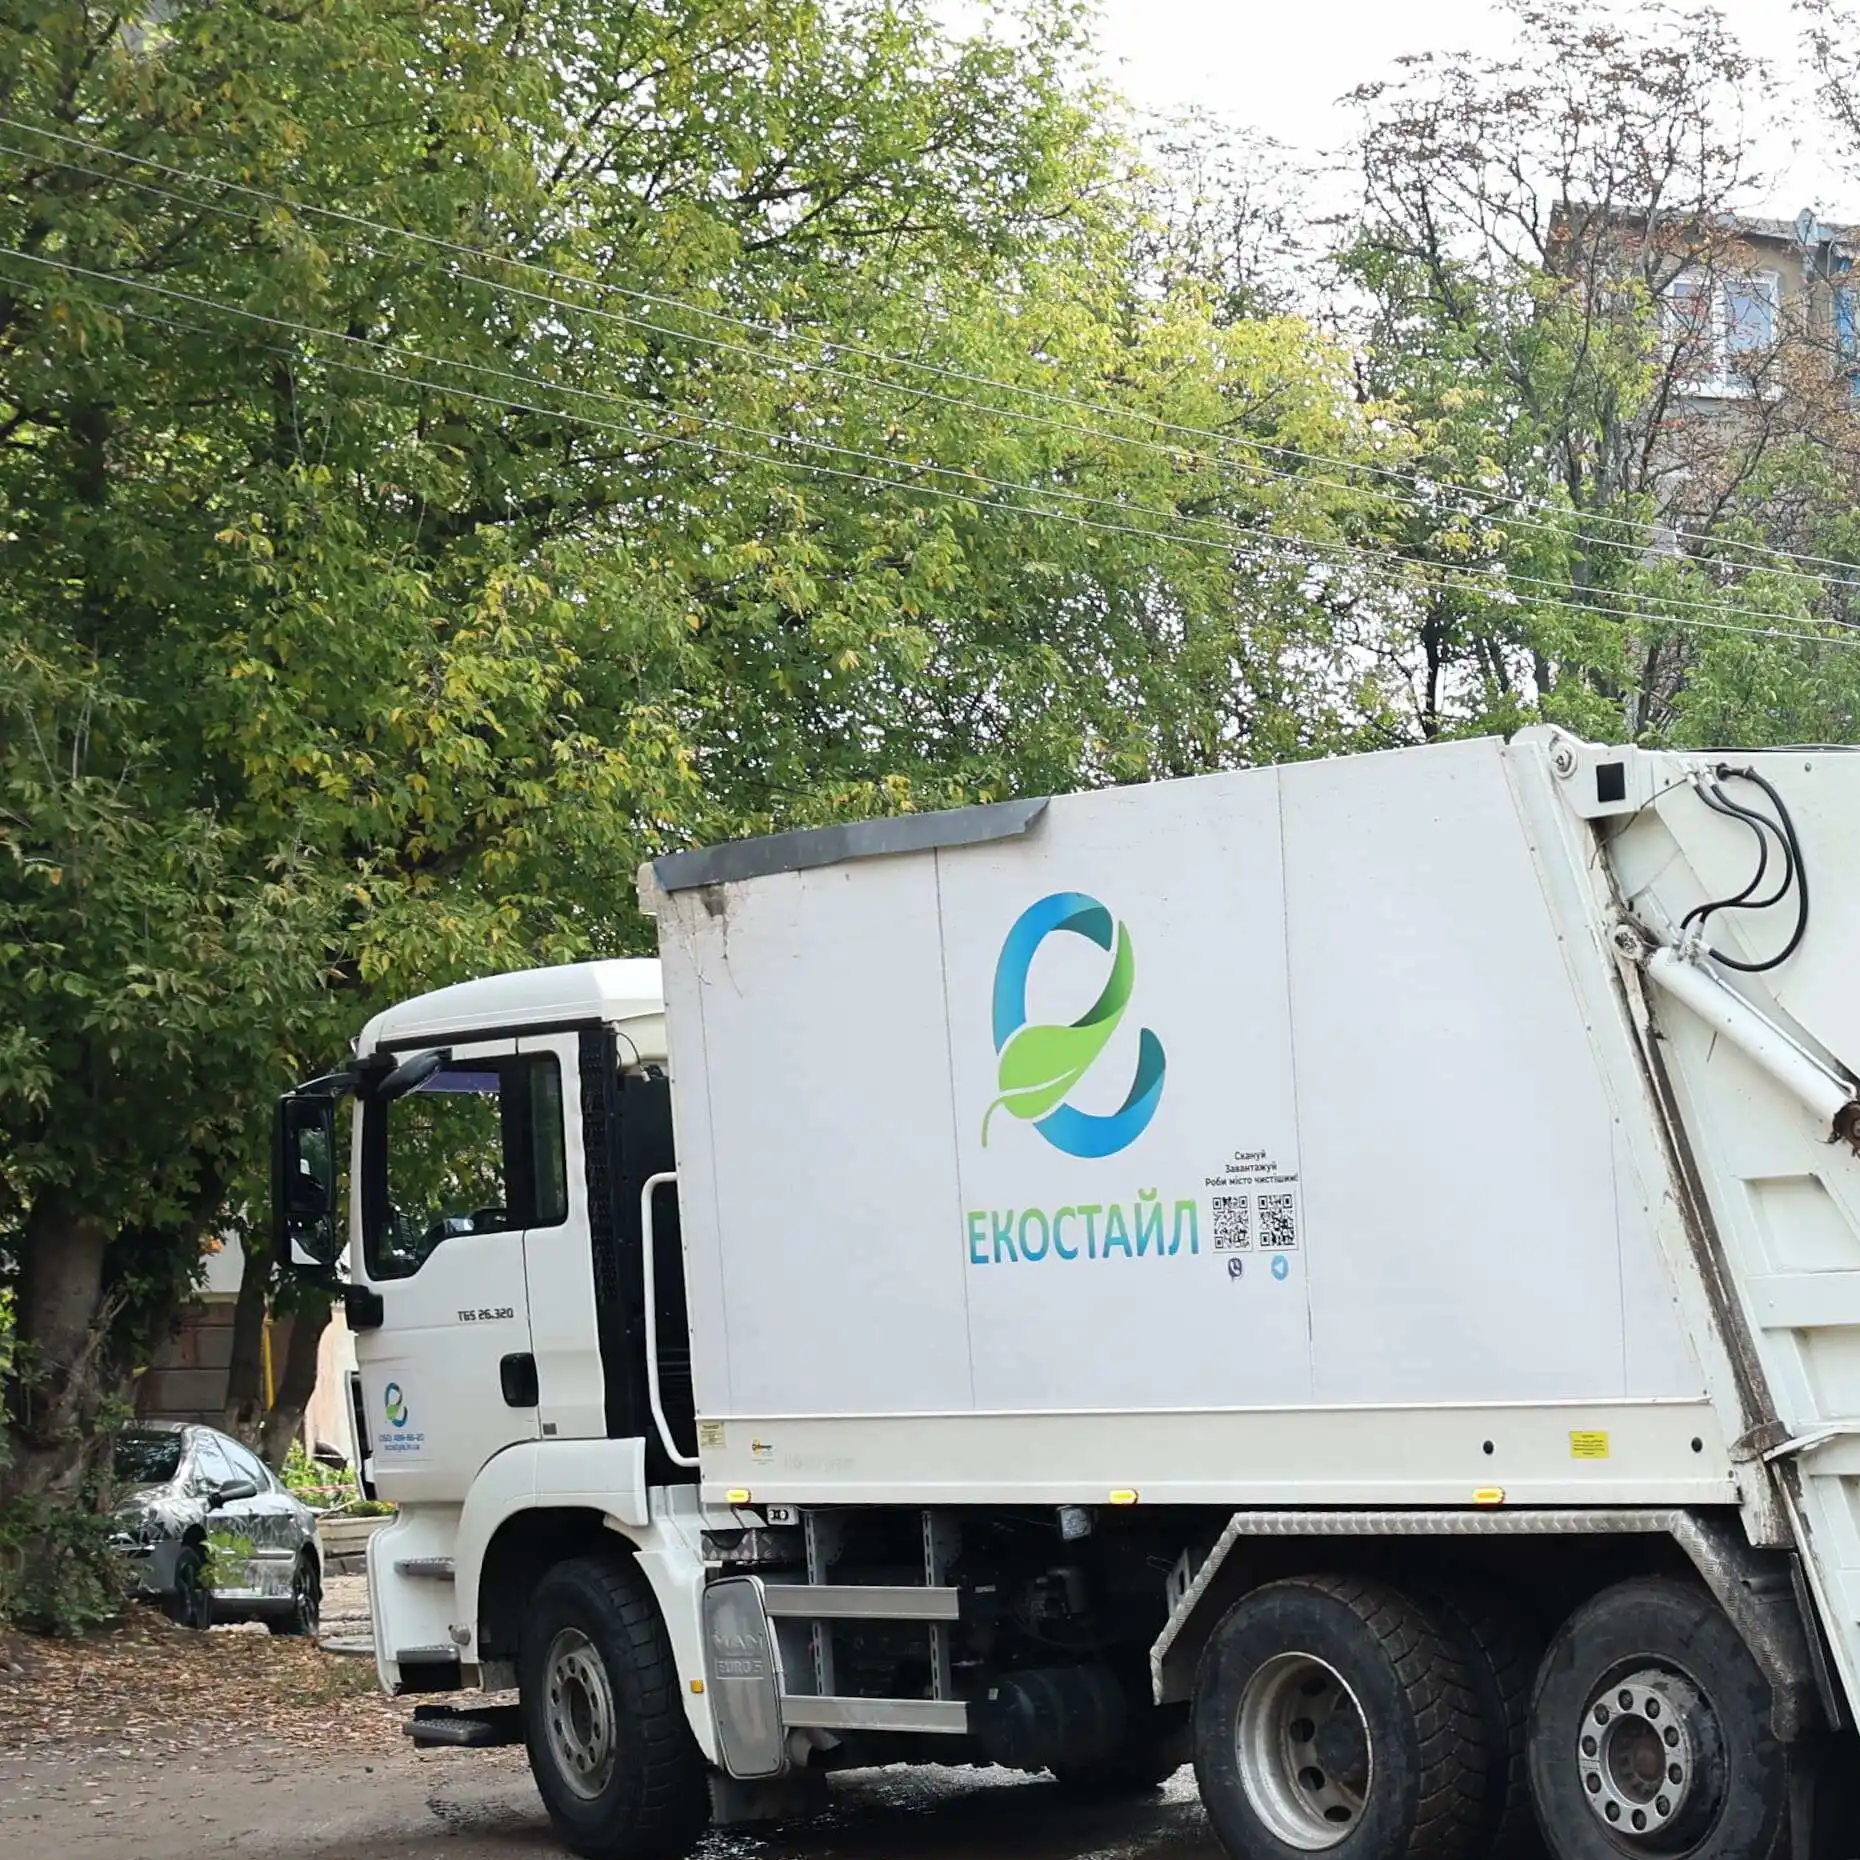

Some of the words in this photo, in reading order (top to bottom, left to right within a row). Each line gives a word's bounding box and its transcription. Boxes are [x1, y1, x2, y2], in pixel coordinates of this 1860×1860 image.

[968, 1187, 1199, 1265] ЕКОСТАЙЛ
[457, 1310, 477, 1322] TGS
[478, 1307, 515, 1321] 26.320
